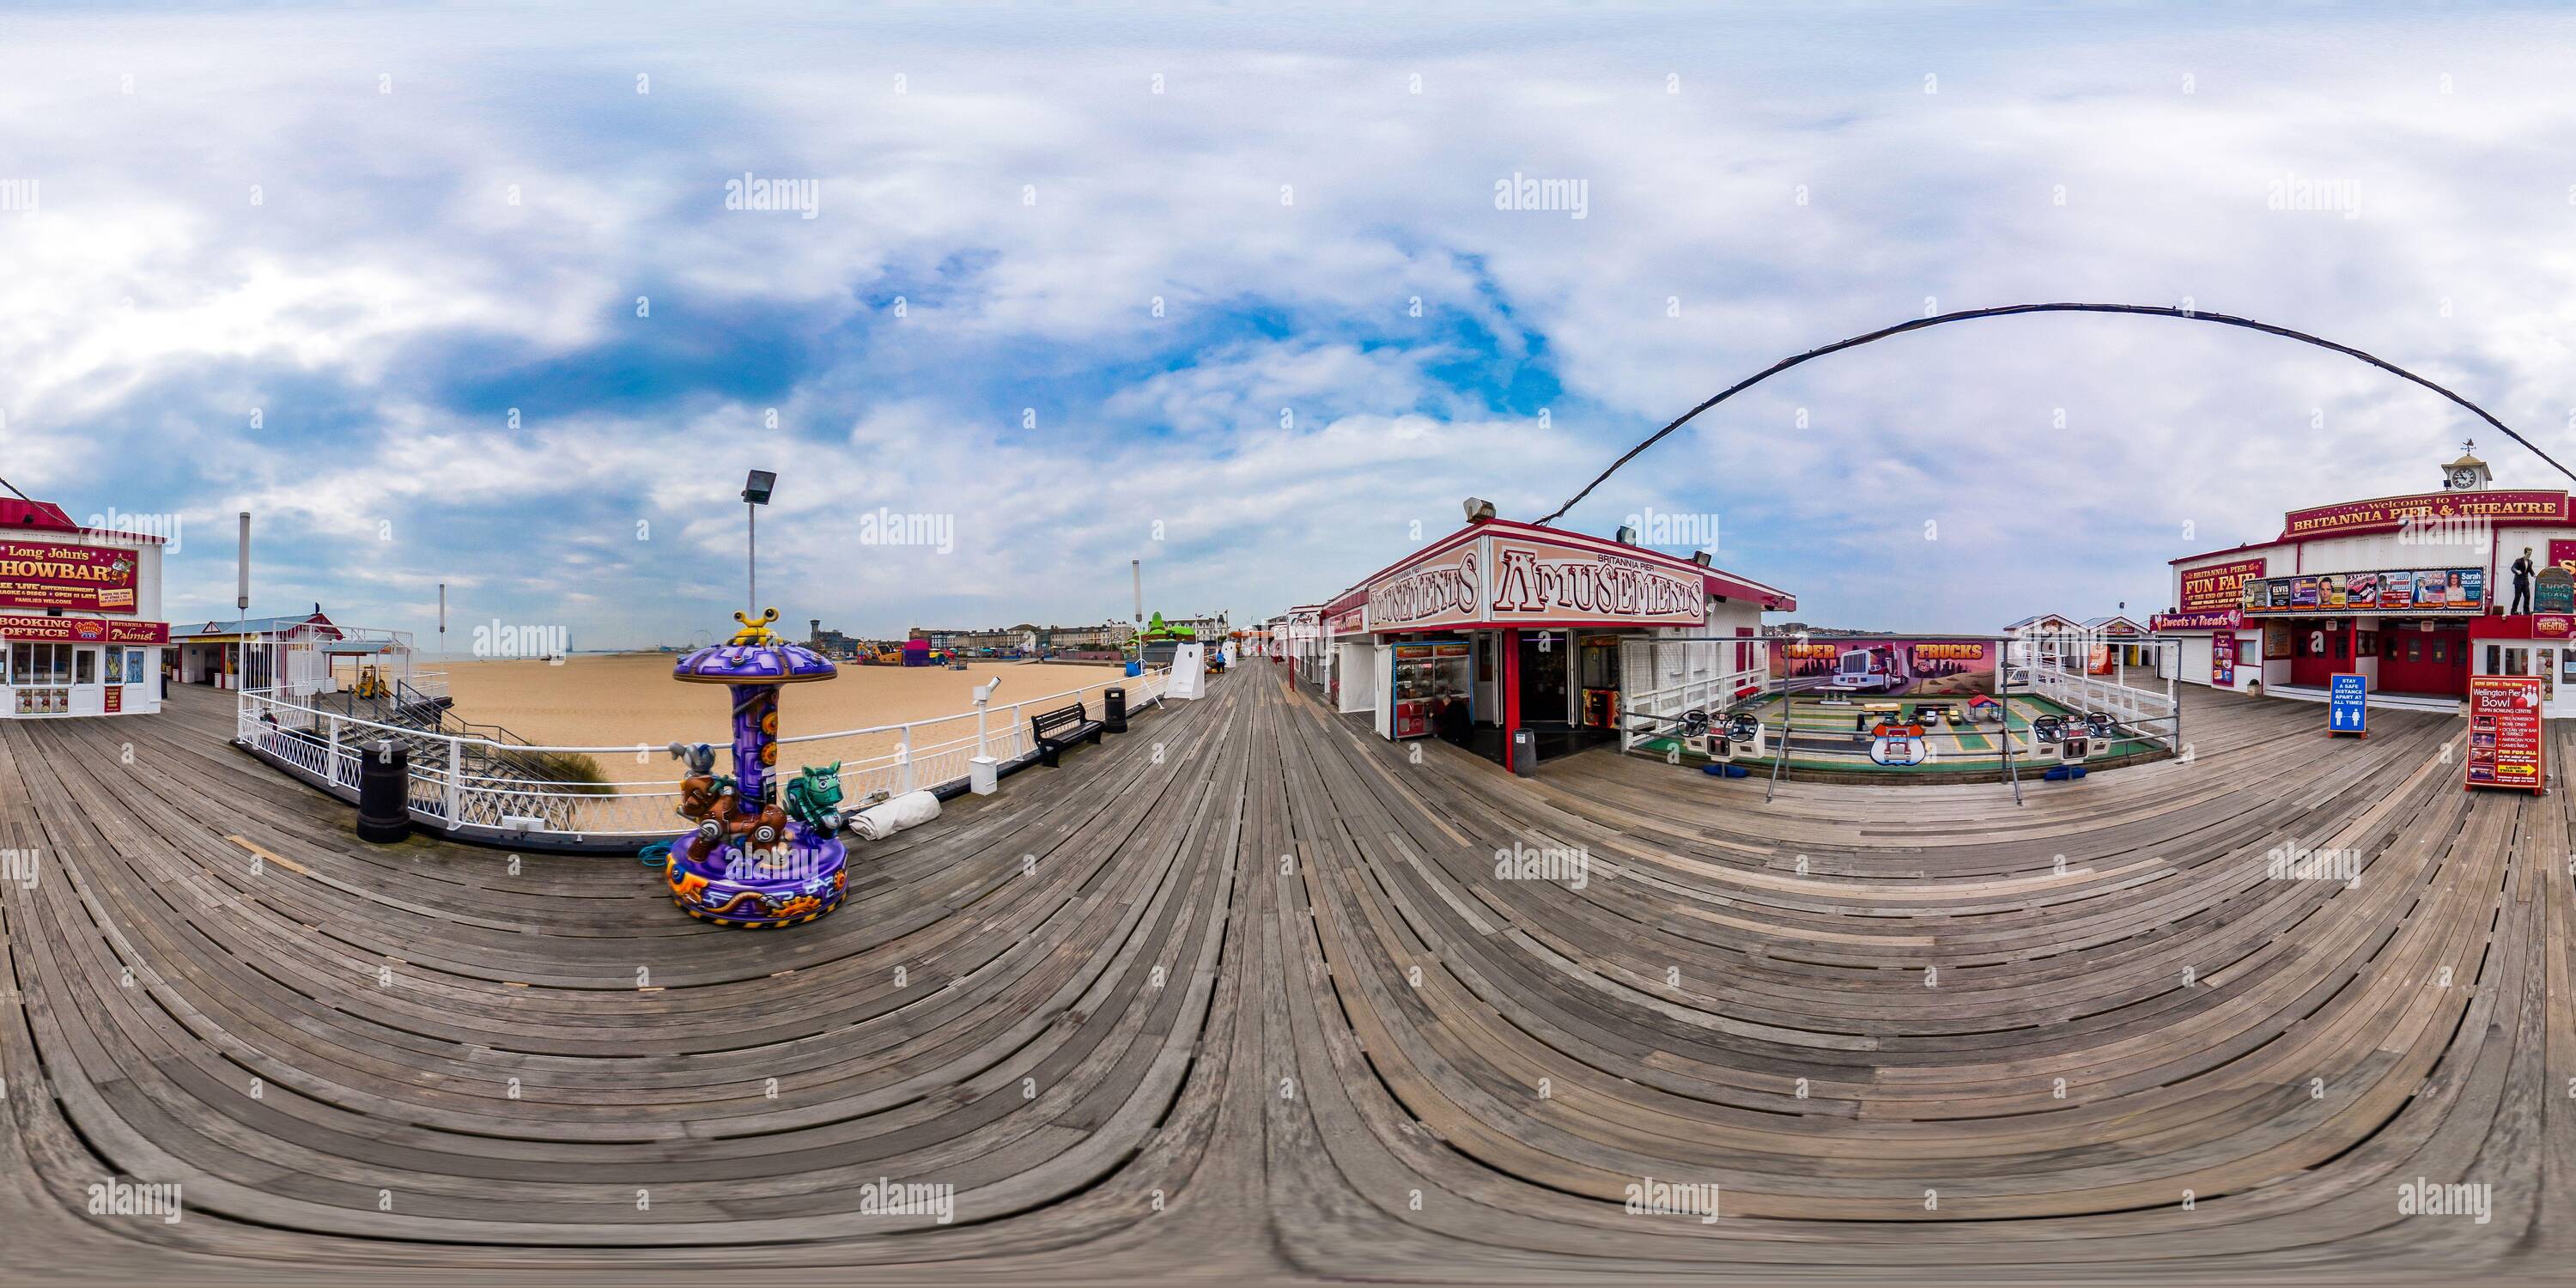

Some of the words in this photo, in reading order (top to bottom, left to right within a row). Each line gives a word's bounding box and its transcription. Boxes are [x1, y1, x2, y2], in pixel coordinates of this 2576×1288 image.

[2369, 499, 2432, 509] Welcome
[2293, 511, 2383, 532] BRITANNIA
[2389, 506, 2434, 519] PIER
[2439, 505, 2455, 515] &
[2459, 502, 2556, 515] THEATRE
[9, 545, 45, 560] Long
[48, 547, 88, 560] John's
[1597, 553, 1638, 568] BRITANNIA
[1640, 562, 1655, 572] PIER
[2193, 568, 2227, 579] BRITANNIA
[1369, 552, 1479, 625] AMUSEMENTS
[1493, 549, 1703, 617] AMUSEMENTS
[2185, 578, 2215, 594] FUN
[0, 618, 71, 628] BOOKING
[2162, 617, 2189, 628] Sweets
[2199, 614, 2227, 626] Treats
[2537, 622, 2568, 631] THEATRE
[0, 627, 69, 637] OFFICE
[111, 628, 156, 641] Palmist
[1780, 644, 1836, 659] SUPER
[1915, 643, 1984, 659] TRUCKS
[2473, 689, 2506, 697] Wellington
[2482, 696, 2510, 708] Bowl
